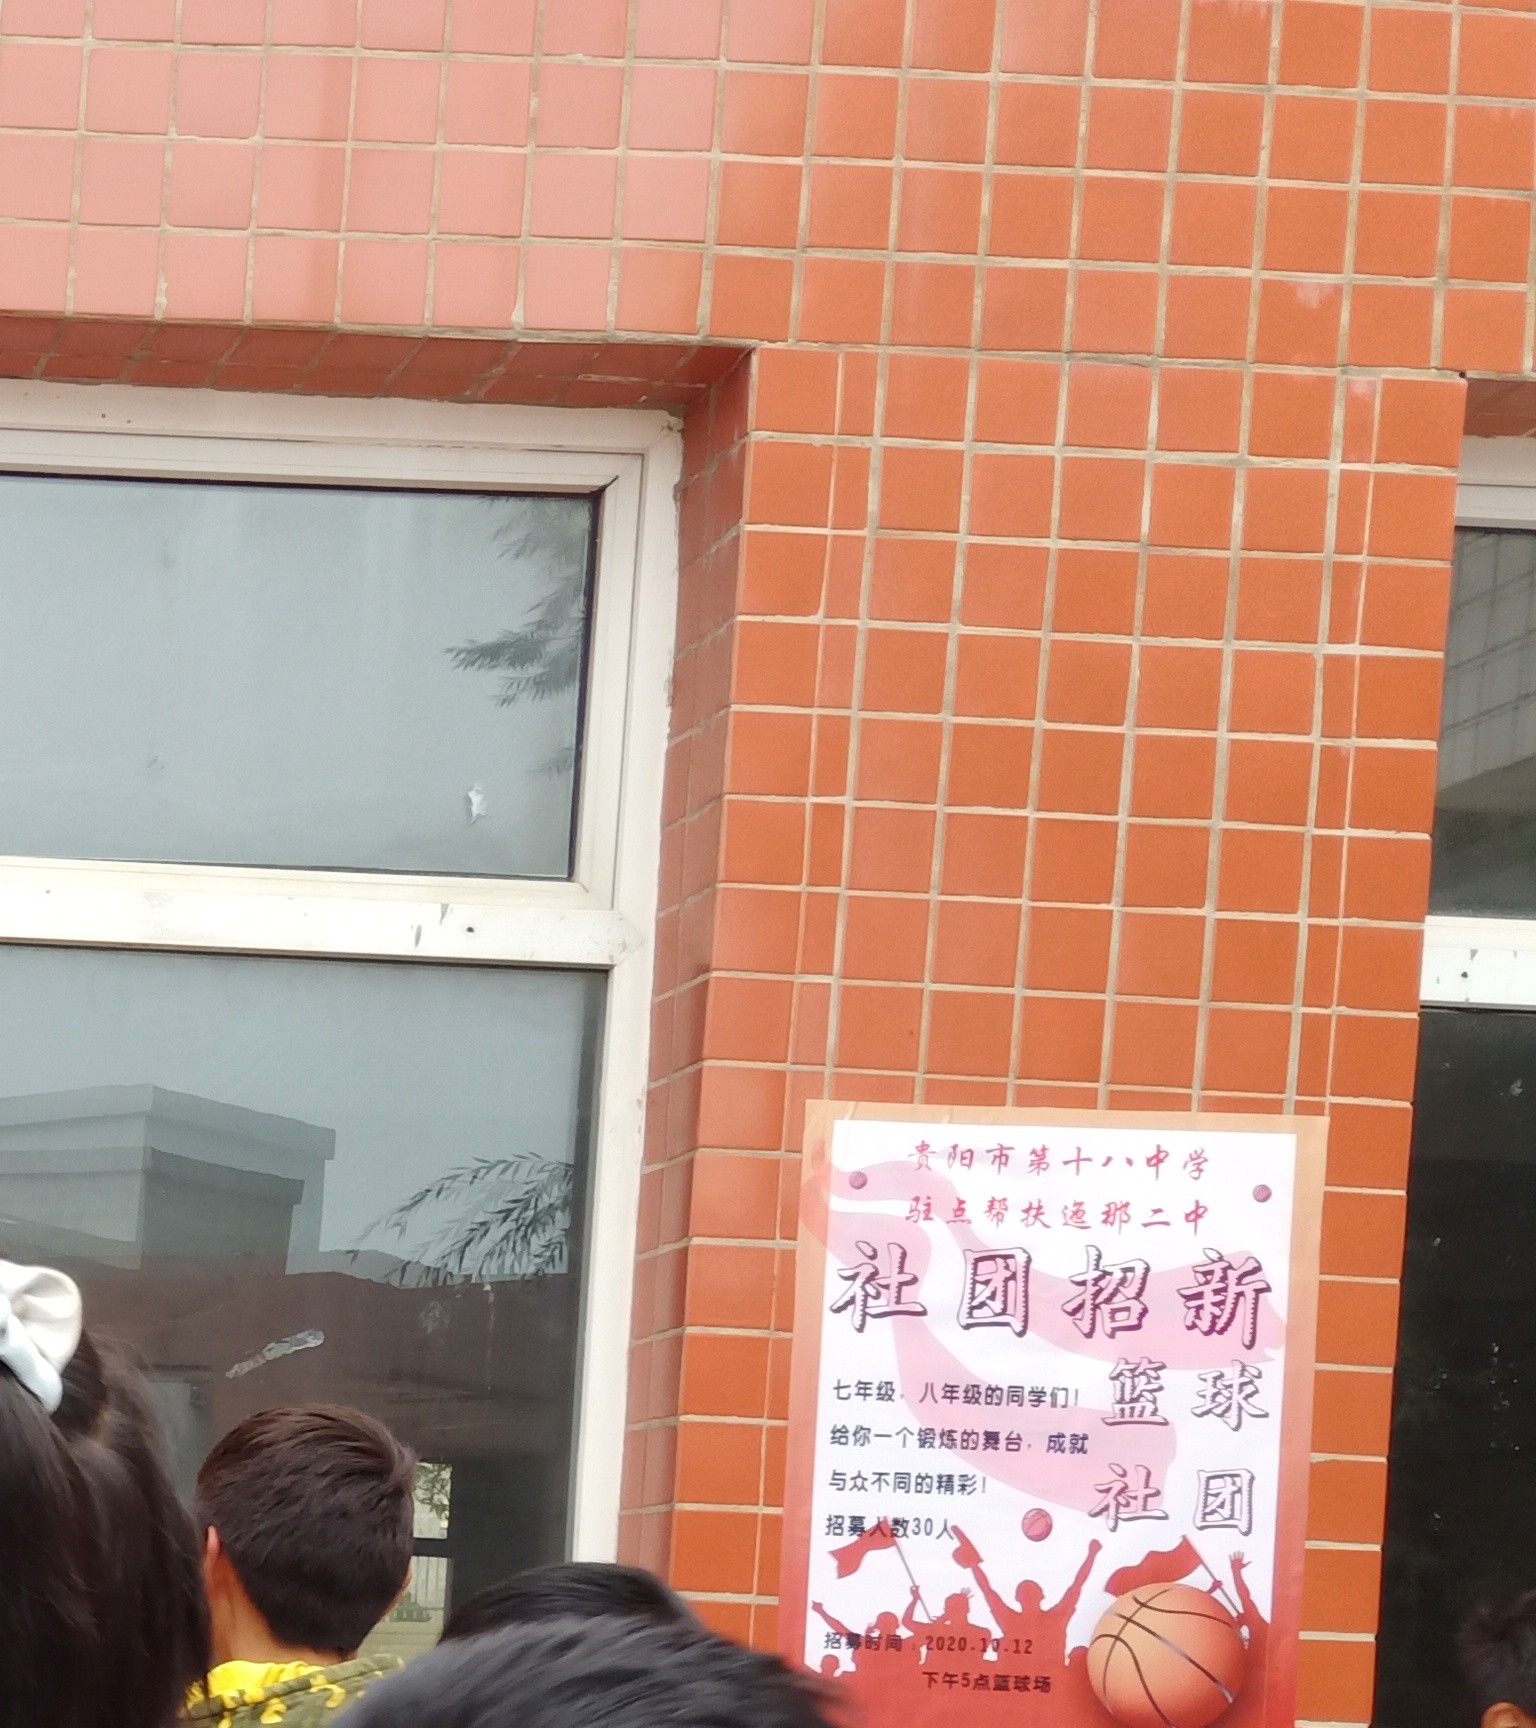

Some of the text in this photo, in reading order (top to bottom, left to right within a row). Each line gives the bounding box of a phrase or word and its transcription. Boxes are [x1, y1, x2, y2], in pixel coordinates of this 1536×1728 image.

[905, 1139, 1211, 1182] 贵阳市第十八中学
[904, 1195, 1211, 1237] 驻点帮扶迤那二中
[829, 1240, 1273, 1350] 社团招新
[1101, 1357, 1269, 1432] 篮球
[1088, 1462, 1255, 1537] 社团
[824, 1514, 955, 1541] 招募人数30人
[921, 1671, 1052, 1694] 下午5点篮球场
